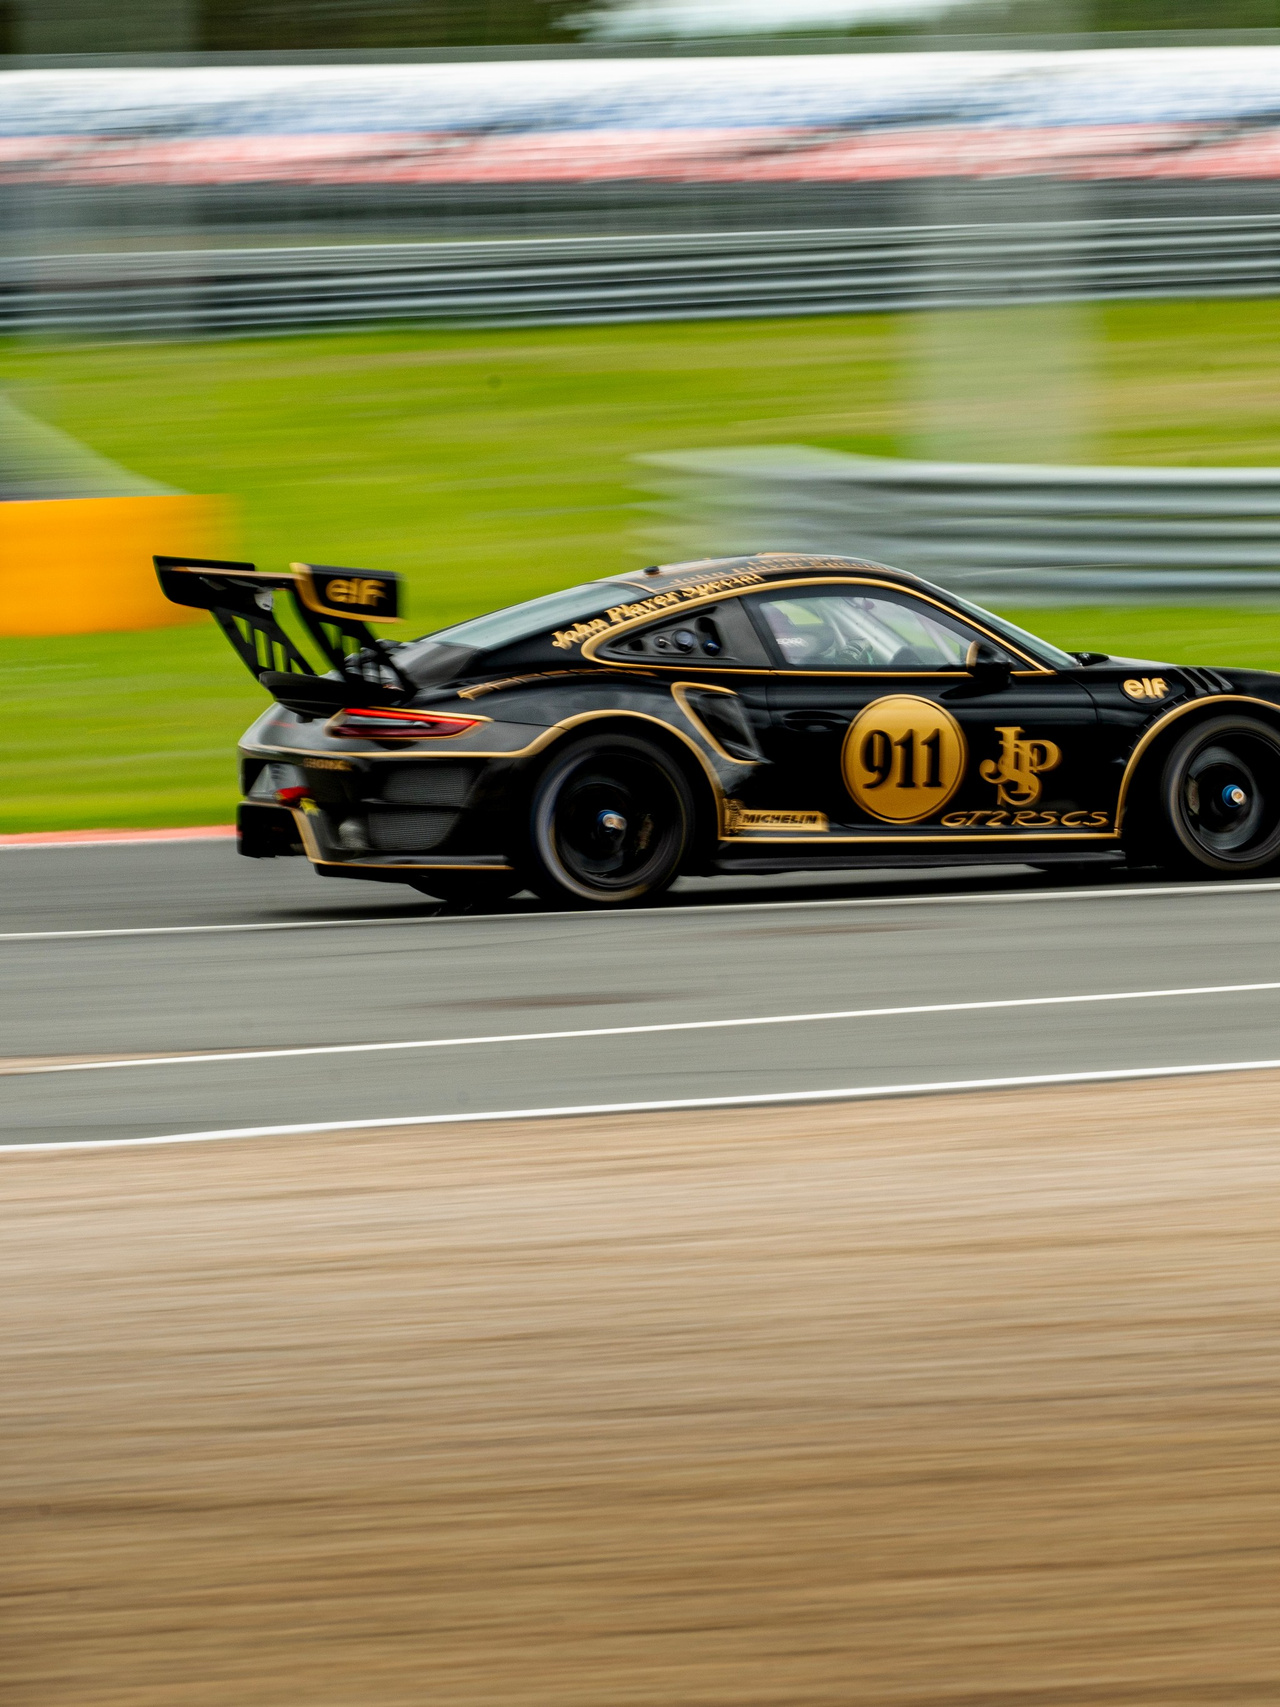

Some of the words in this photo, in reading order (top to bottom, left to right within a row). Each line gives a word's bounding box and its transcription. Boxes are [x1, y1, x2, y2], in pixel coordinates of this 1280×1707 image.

[325, 577, 388, 607] elf
[551, 617, 611, 650] John
[604, 590, 684, 624] Player
[680, 571, 768, 599] Special
[1123, 677, 1169, 699] elf
[861, 727, 942, 790] 911
[742, 814, 818, 825] MICHELIN
